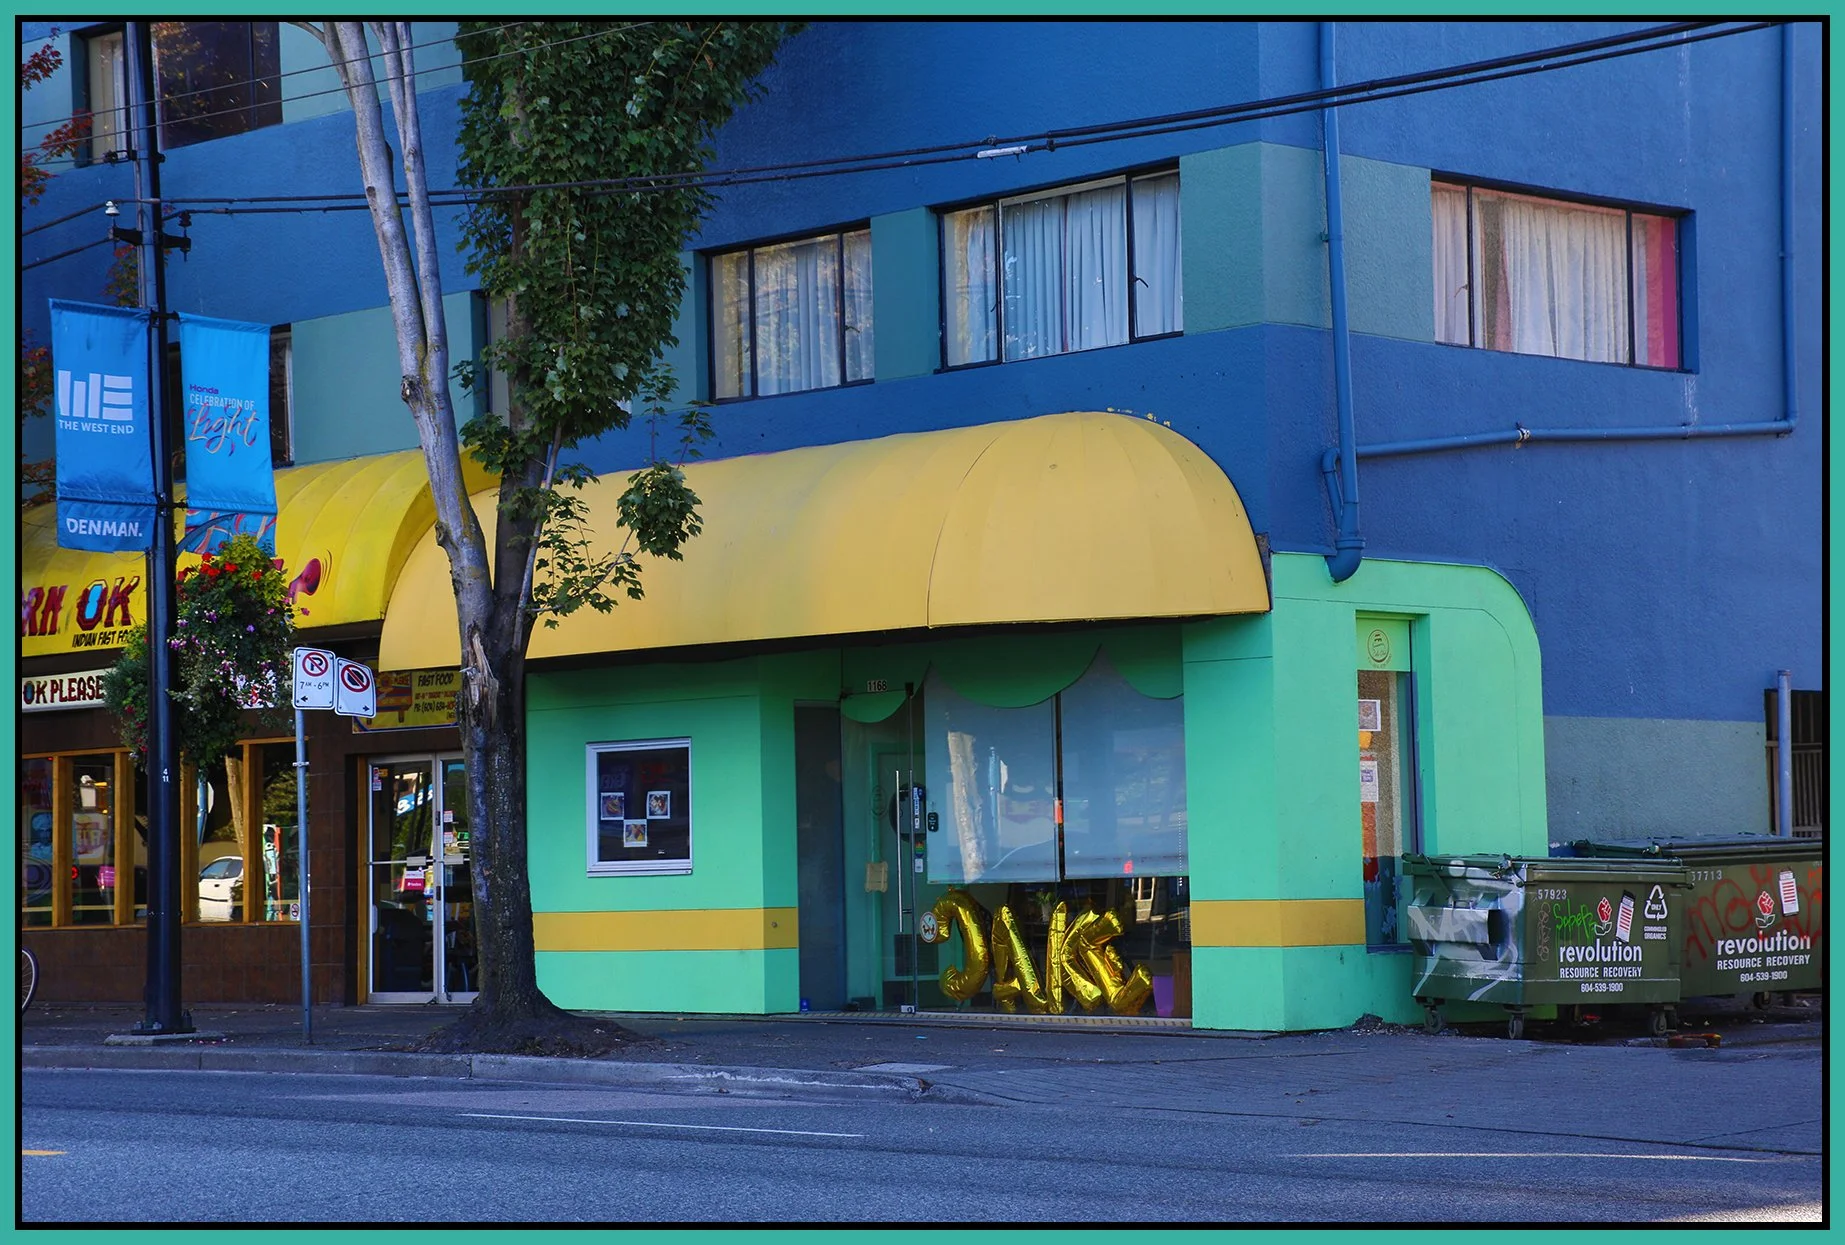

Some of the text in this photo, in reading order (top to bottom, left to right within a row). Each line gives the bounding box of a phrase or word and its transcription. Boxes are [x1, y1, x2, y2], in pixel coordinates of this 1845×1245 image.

[190, 384, 219, 394] Honda
[190, 394, 255, 410] CELEBRATION OF
[59, 420, 134, 434] THE WEST END
[187, 403, 260, 457] Light
[66, 518, 142, 537] DENMAN.
[22, 576, 140, 637] RN OK
[72, 633, 98, 648] INDIAN
[97, 631, 116, 646] FAST
[418, 675, 435, 687] FAST
[435, 672, 454, 685] FOOD
[868, 680, 887, 691] 1168
[23, 675, 104, 705] OK PLEASE
[1538, 889, 1567, 900] 57923
[1717, 929, 1811, 955] revolution
[1560, 938, 1642, 963] revolution
[1717, 954, 1811, 970] RESOURCE RECOVERY
[1560, 966, 1642, 978] RESOURCE RECOVERY
[1740, 971, 1788, 982] 604-539-1900
[1581, 982, 1624, 993] 604-539-1900
